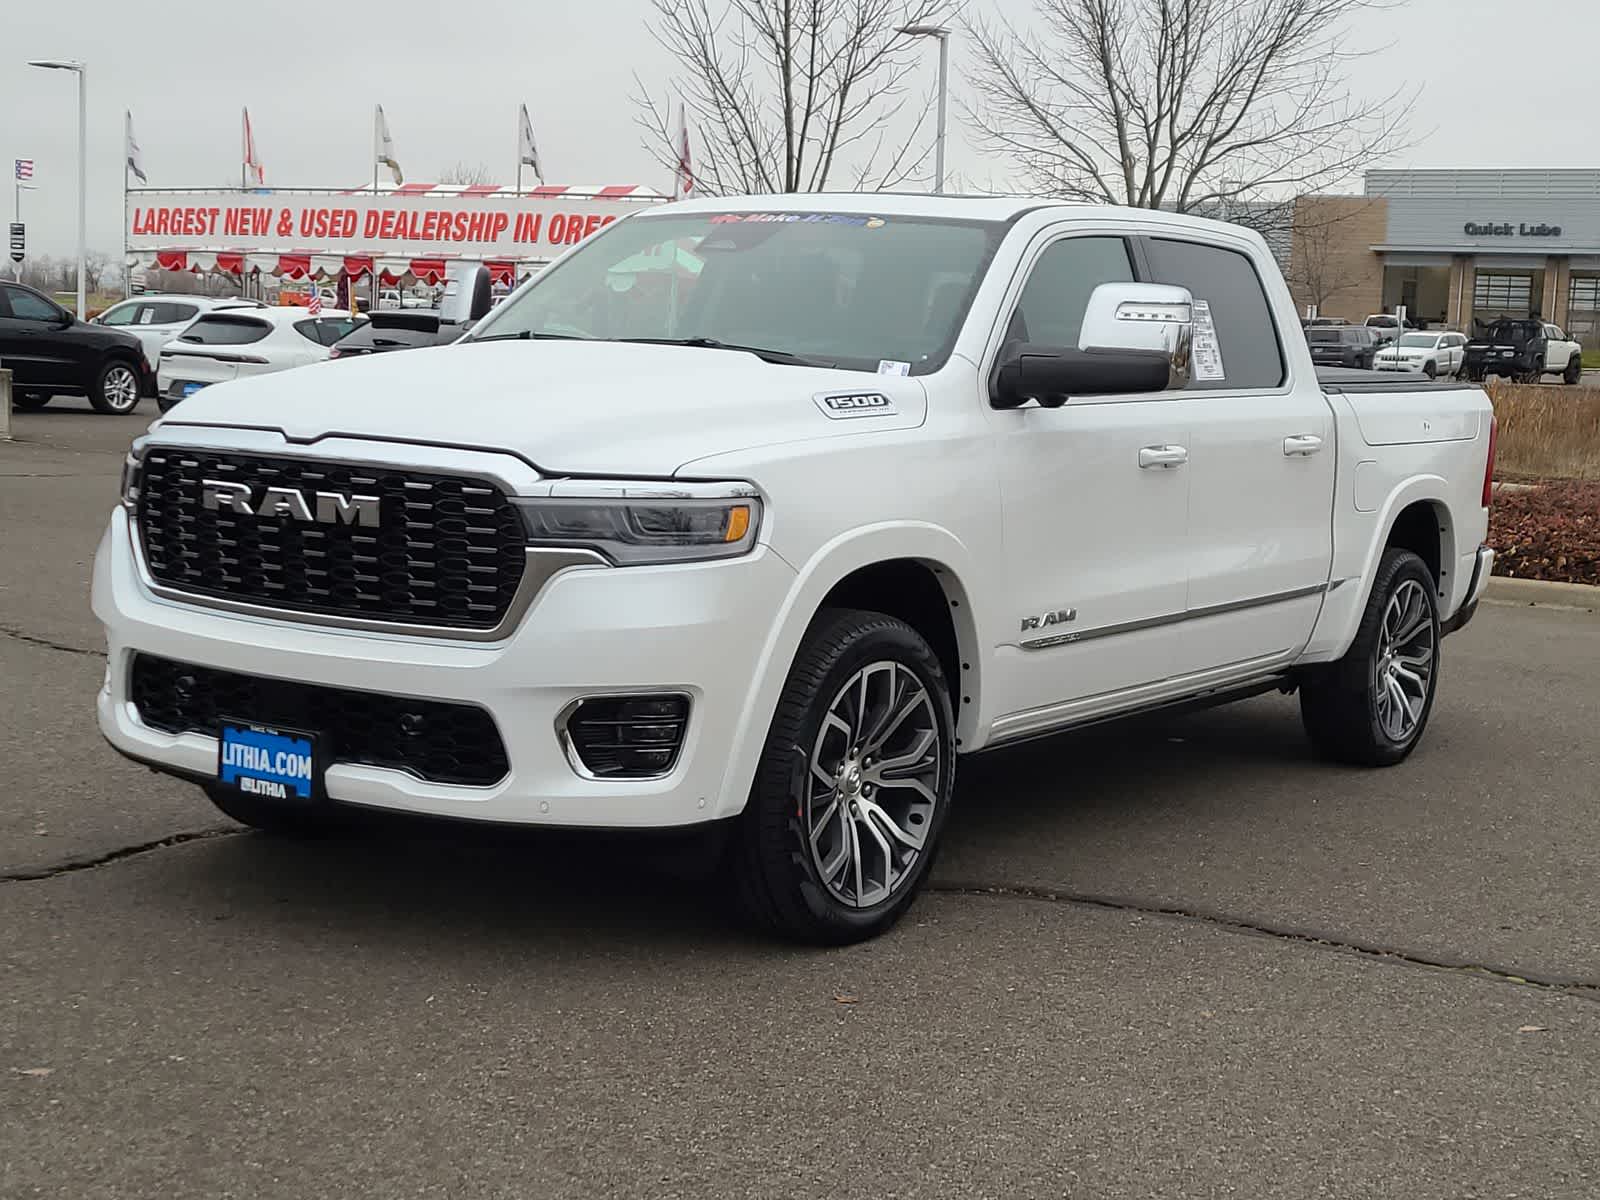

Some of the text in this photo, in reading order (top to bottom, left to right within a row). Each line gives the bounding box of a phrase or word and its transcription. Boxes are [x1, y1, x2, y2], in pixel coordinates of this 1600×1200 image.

[132, 207, 219, 236] LARGEST
[223, 208, 273, 237] NEW
[276, 208, 294, 237] &
[299, 209, 358, 238] USED
[363, 209, 508, 242] DEALERSHIP
[512, 213, 543, 244] IN
[1464, 222, 1562, 236] Quick Lube
[826, 394, 887, 409] 1500
[202, 480, 381, 528] RAM
[1021, 608, 1077, 632] RAM
[222, 741, 312, 780] LITHIA.COM
[252, 778, 287, 799] LITHIA
